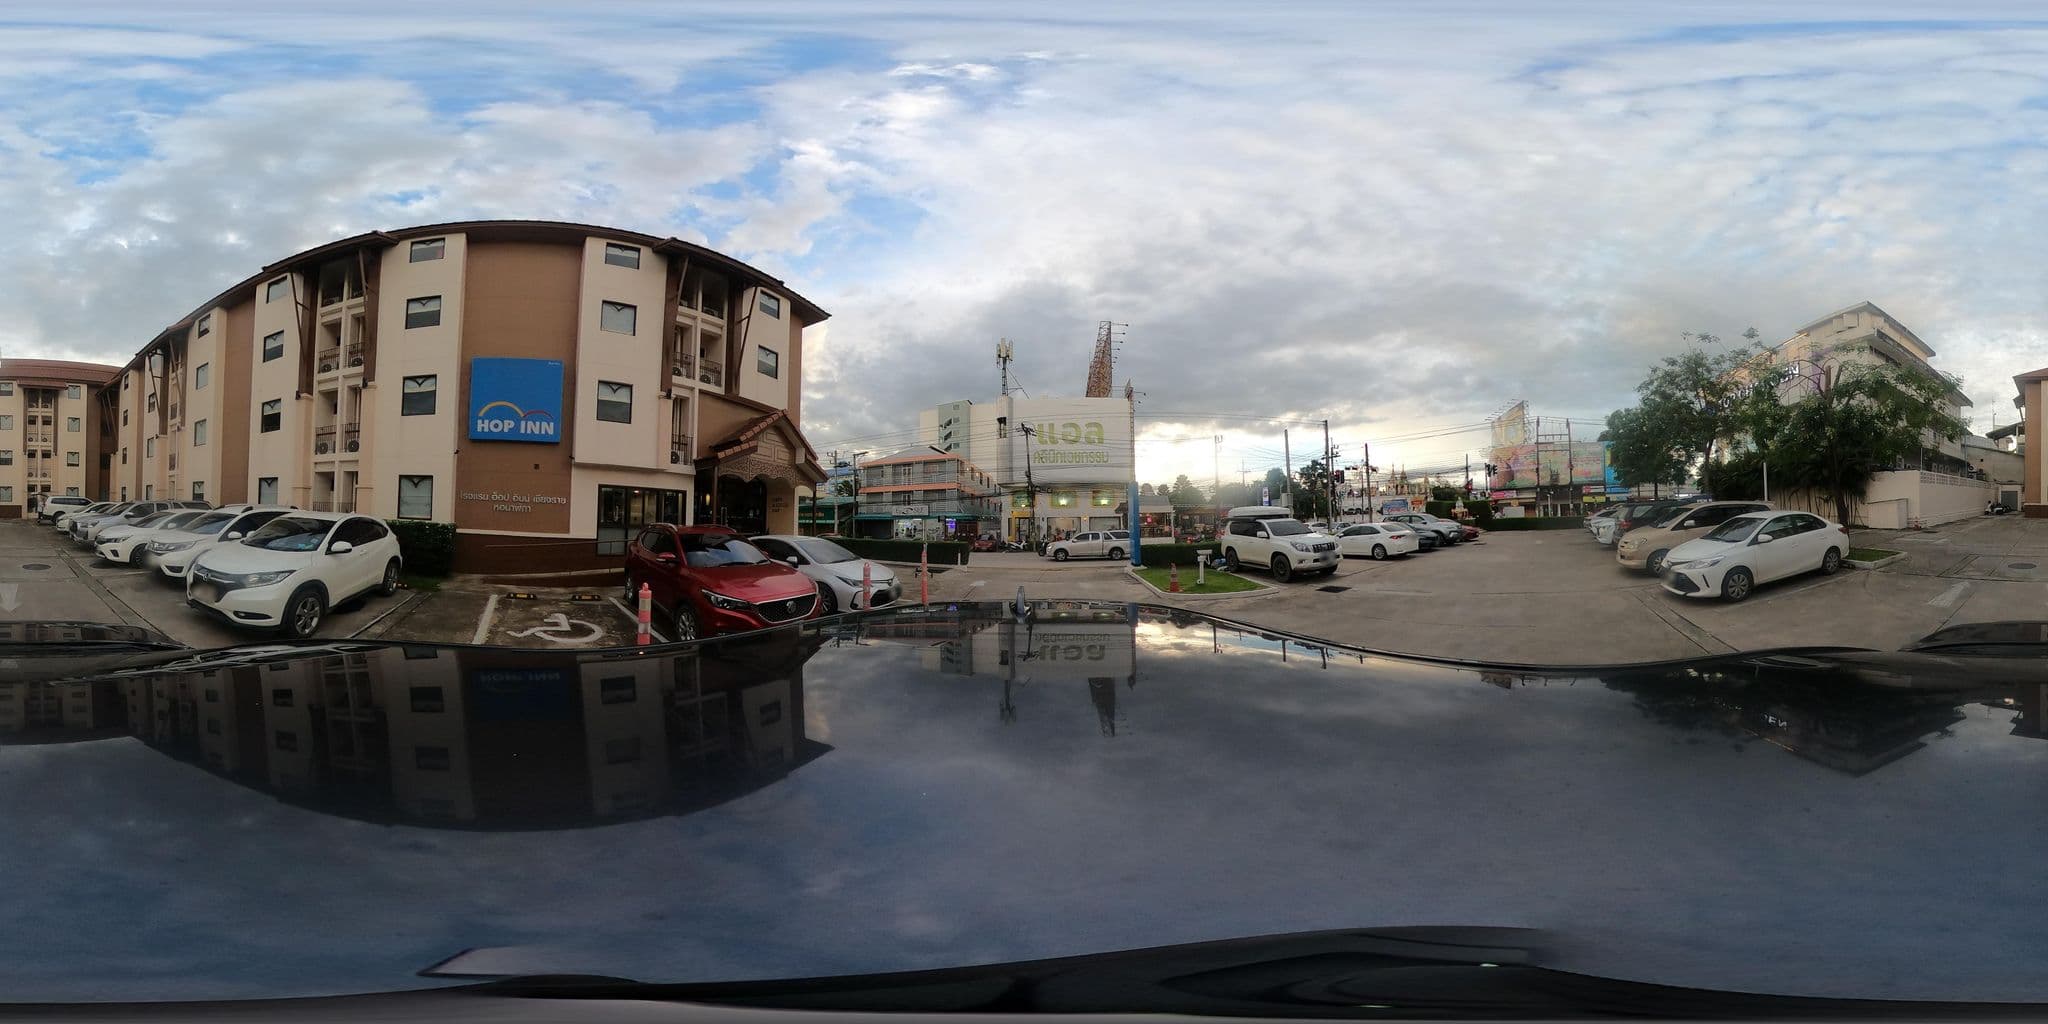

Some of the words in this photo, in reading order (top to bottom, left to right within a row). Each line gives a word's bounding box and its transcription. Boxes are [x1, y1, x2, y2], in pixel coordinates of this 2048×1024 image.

[477, 419, 515, 433] HOP
[520, 420, 554, 435] INN
[1037, 421, 1105, 445] แอล
[1033, 449, 1110, 464] คลินิกเวชกรรม
